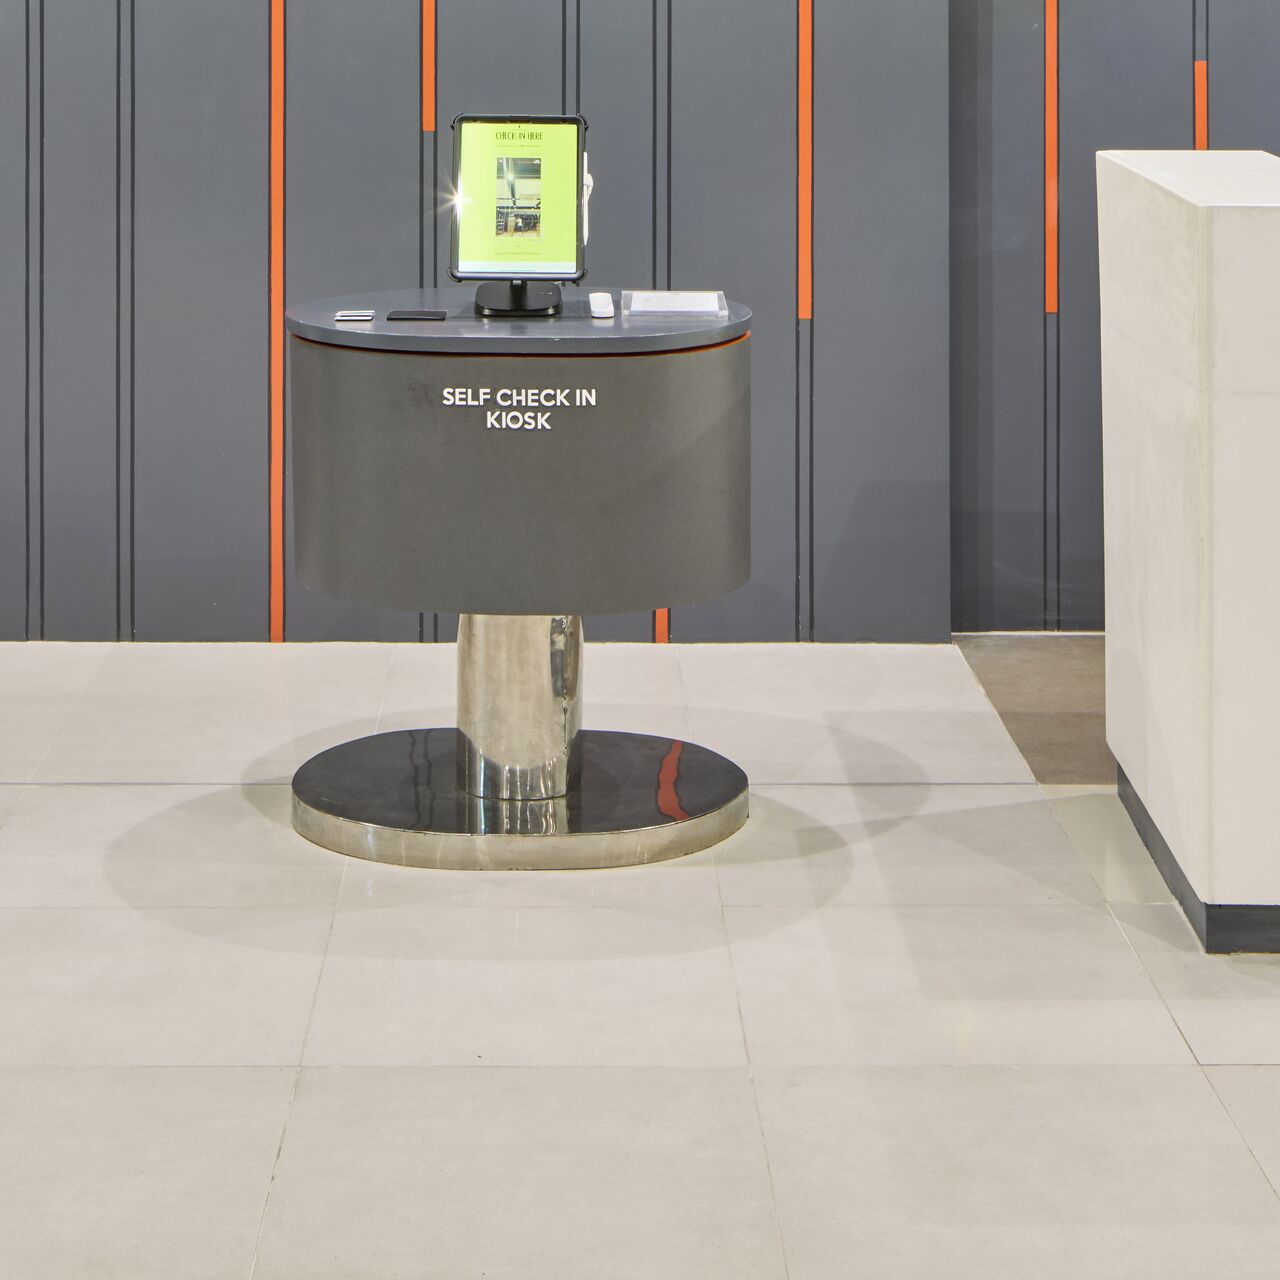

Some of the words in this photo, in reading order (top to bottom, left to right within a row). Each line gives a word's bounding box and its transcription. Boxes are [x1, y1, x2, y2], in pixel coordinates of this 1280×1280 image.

[442, 387, 491, 406] SELF
[496, 388, 571, 407] CHECK
[575, 388, 597, 407] IN
[486, 410, 552, 430] KIOSK
